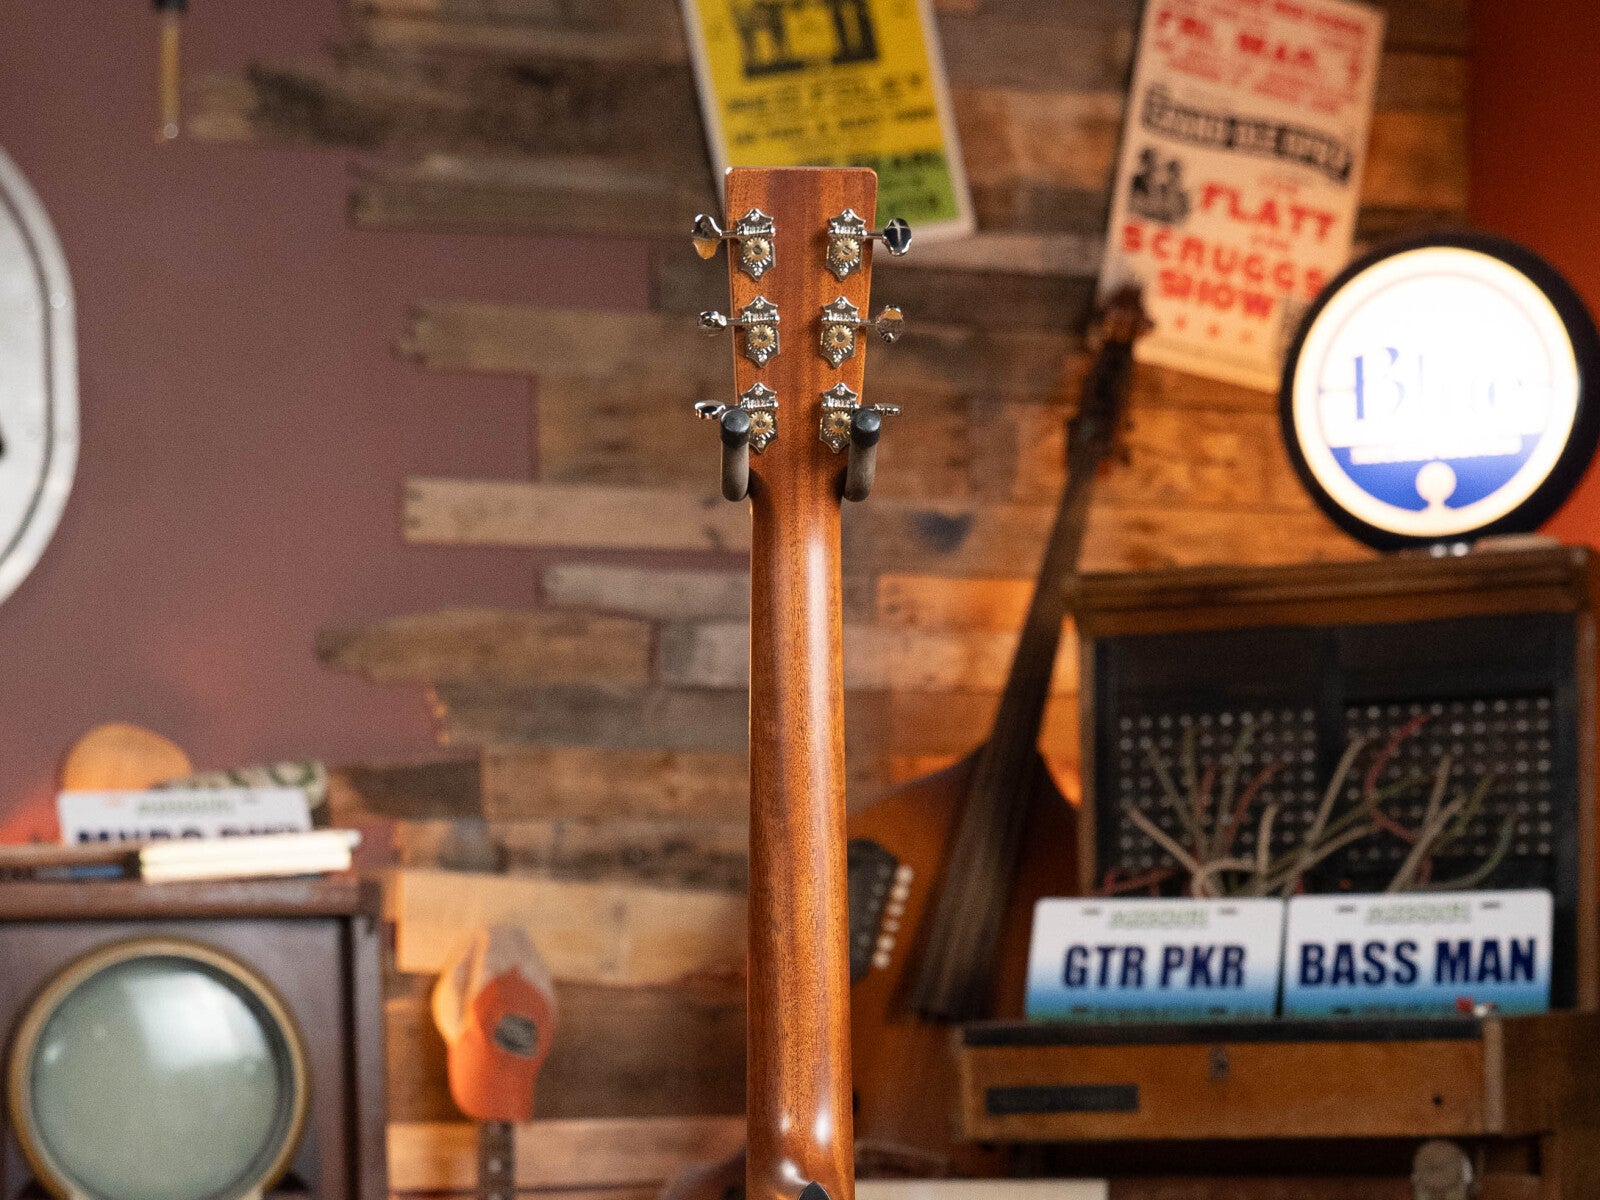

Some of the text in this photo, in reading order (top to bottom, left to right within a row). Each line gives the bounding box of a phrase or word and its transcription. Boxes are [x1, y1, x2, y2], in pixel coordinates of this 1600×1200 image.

[1201, 181, 1338, 243] FLATT
[1121, 219, 1328, 299] SCRUGGS
[1158, 268, 1274, 320] SHOW
[1062, 944, 1247, 989] GTR PKR
[1299, 938, 1535, 986] BASS MAN
